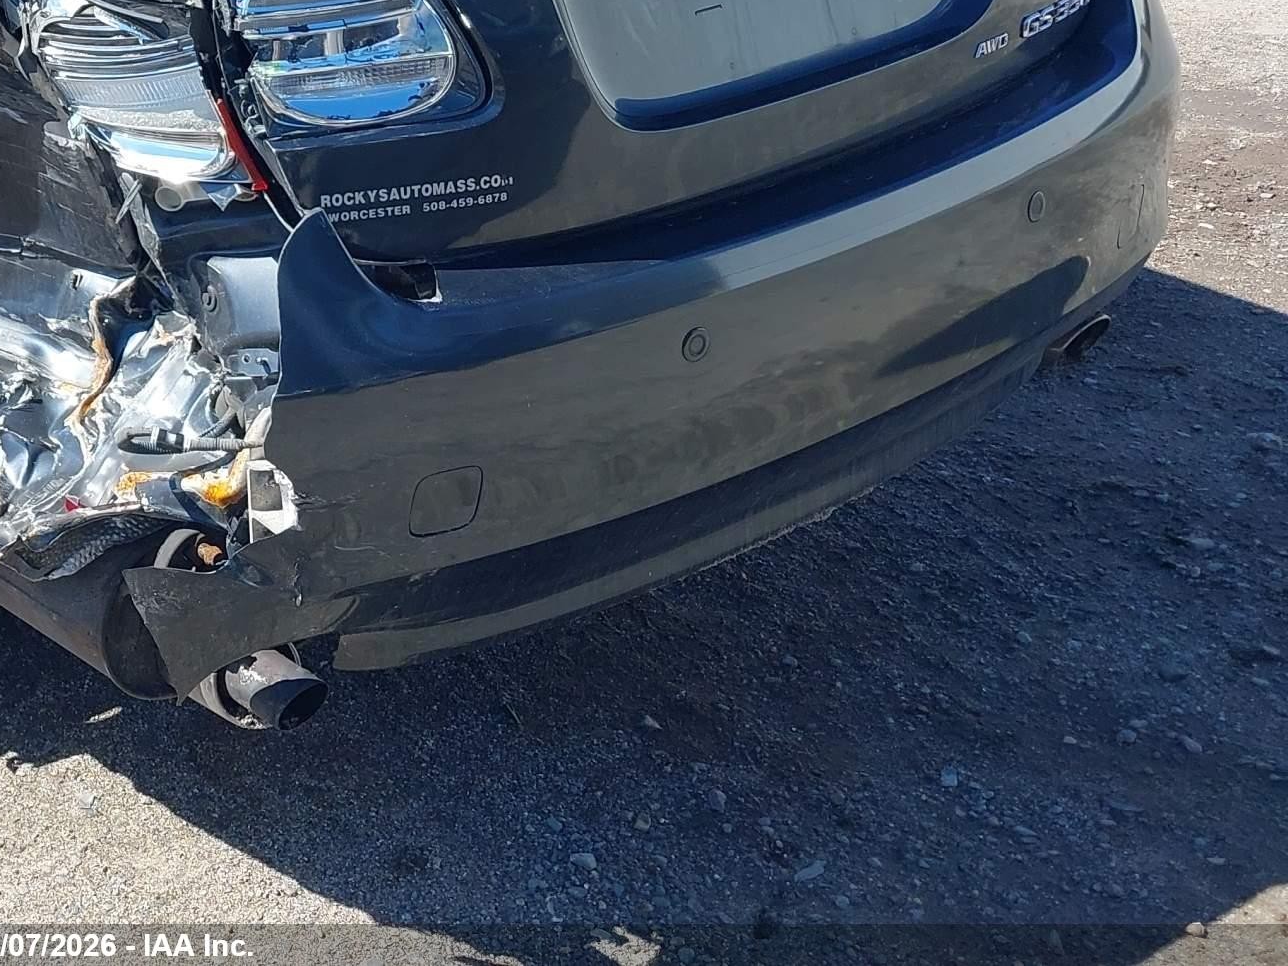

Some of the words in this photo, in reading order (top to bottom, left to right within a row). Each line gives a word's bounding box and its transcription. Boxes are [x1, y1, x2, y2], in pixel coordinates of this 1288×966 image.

[974, 33, 1009, 58] AWD
[328, 205, 411, 223] WORCESTER
[422, 192, 508, 212] 508-459-6878
